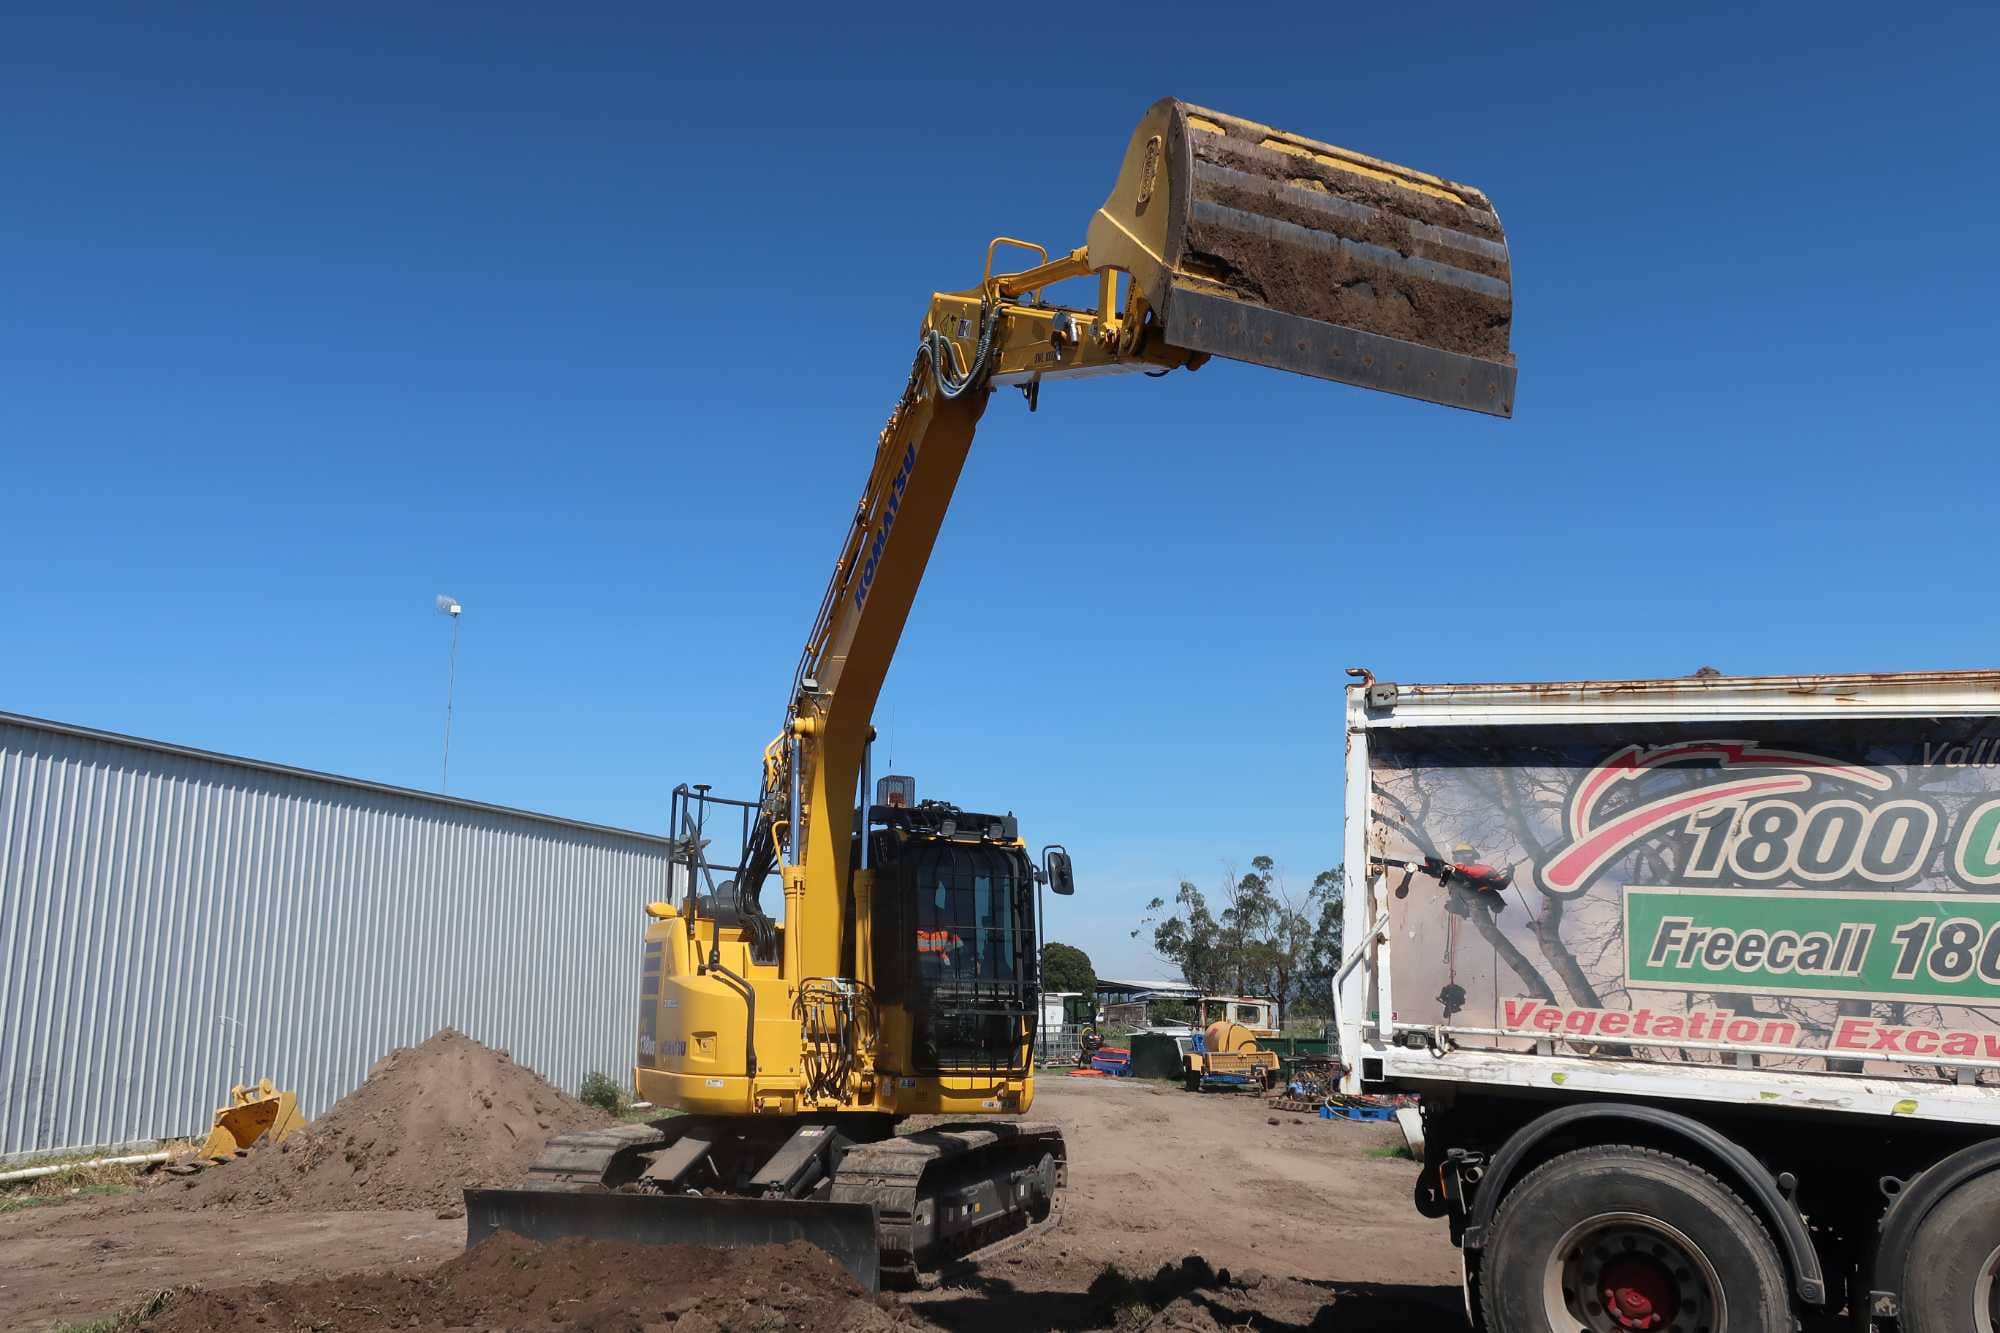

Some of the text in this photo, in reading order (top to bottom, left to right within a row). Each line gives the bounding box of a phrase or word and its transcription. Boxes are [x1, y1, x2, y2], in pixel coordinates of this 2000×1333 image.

[855, 441, 916, 612] KOMATSU
[1683, 799, 1938, 883] 1800
[1647, 916, 1876, 978] Freecall
[1504, 1000, 1797, 1045] Vegetation
